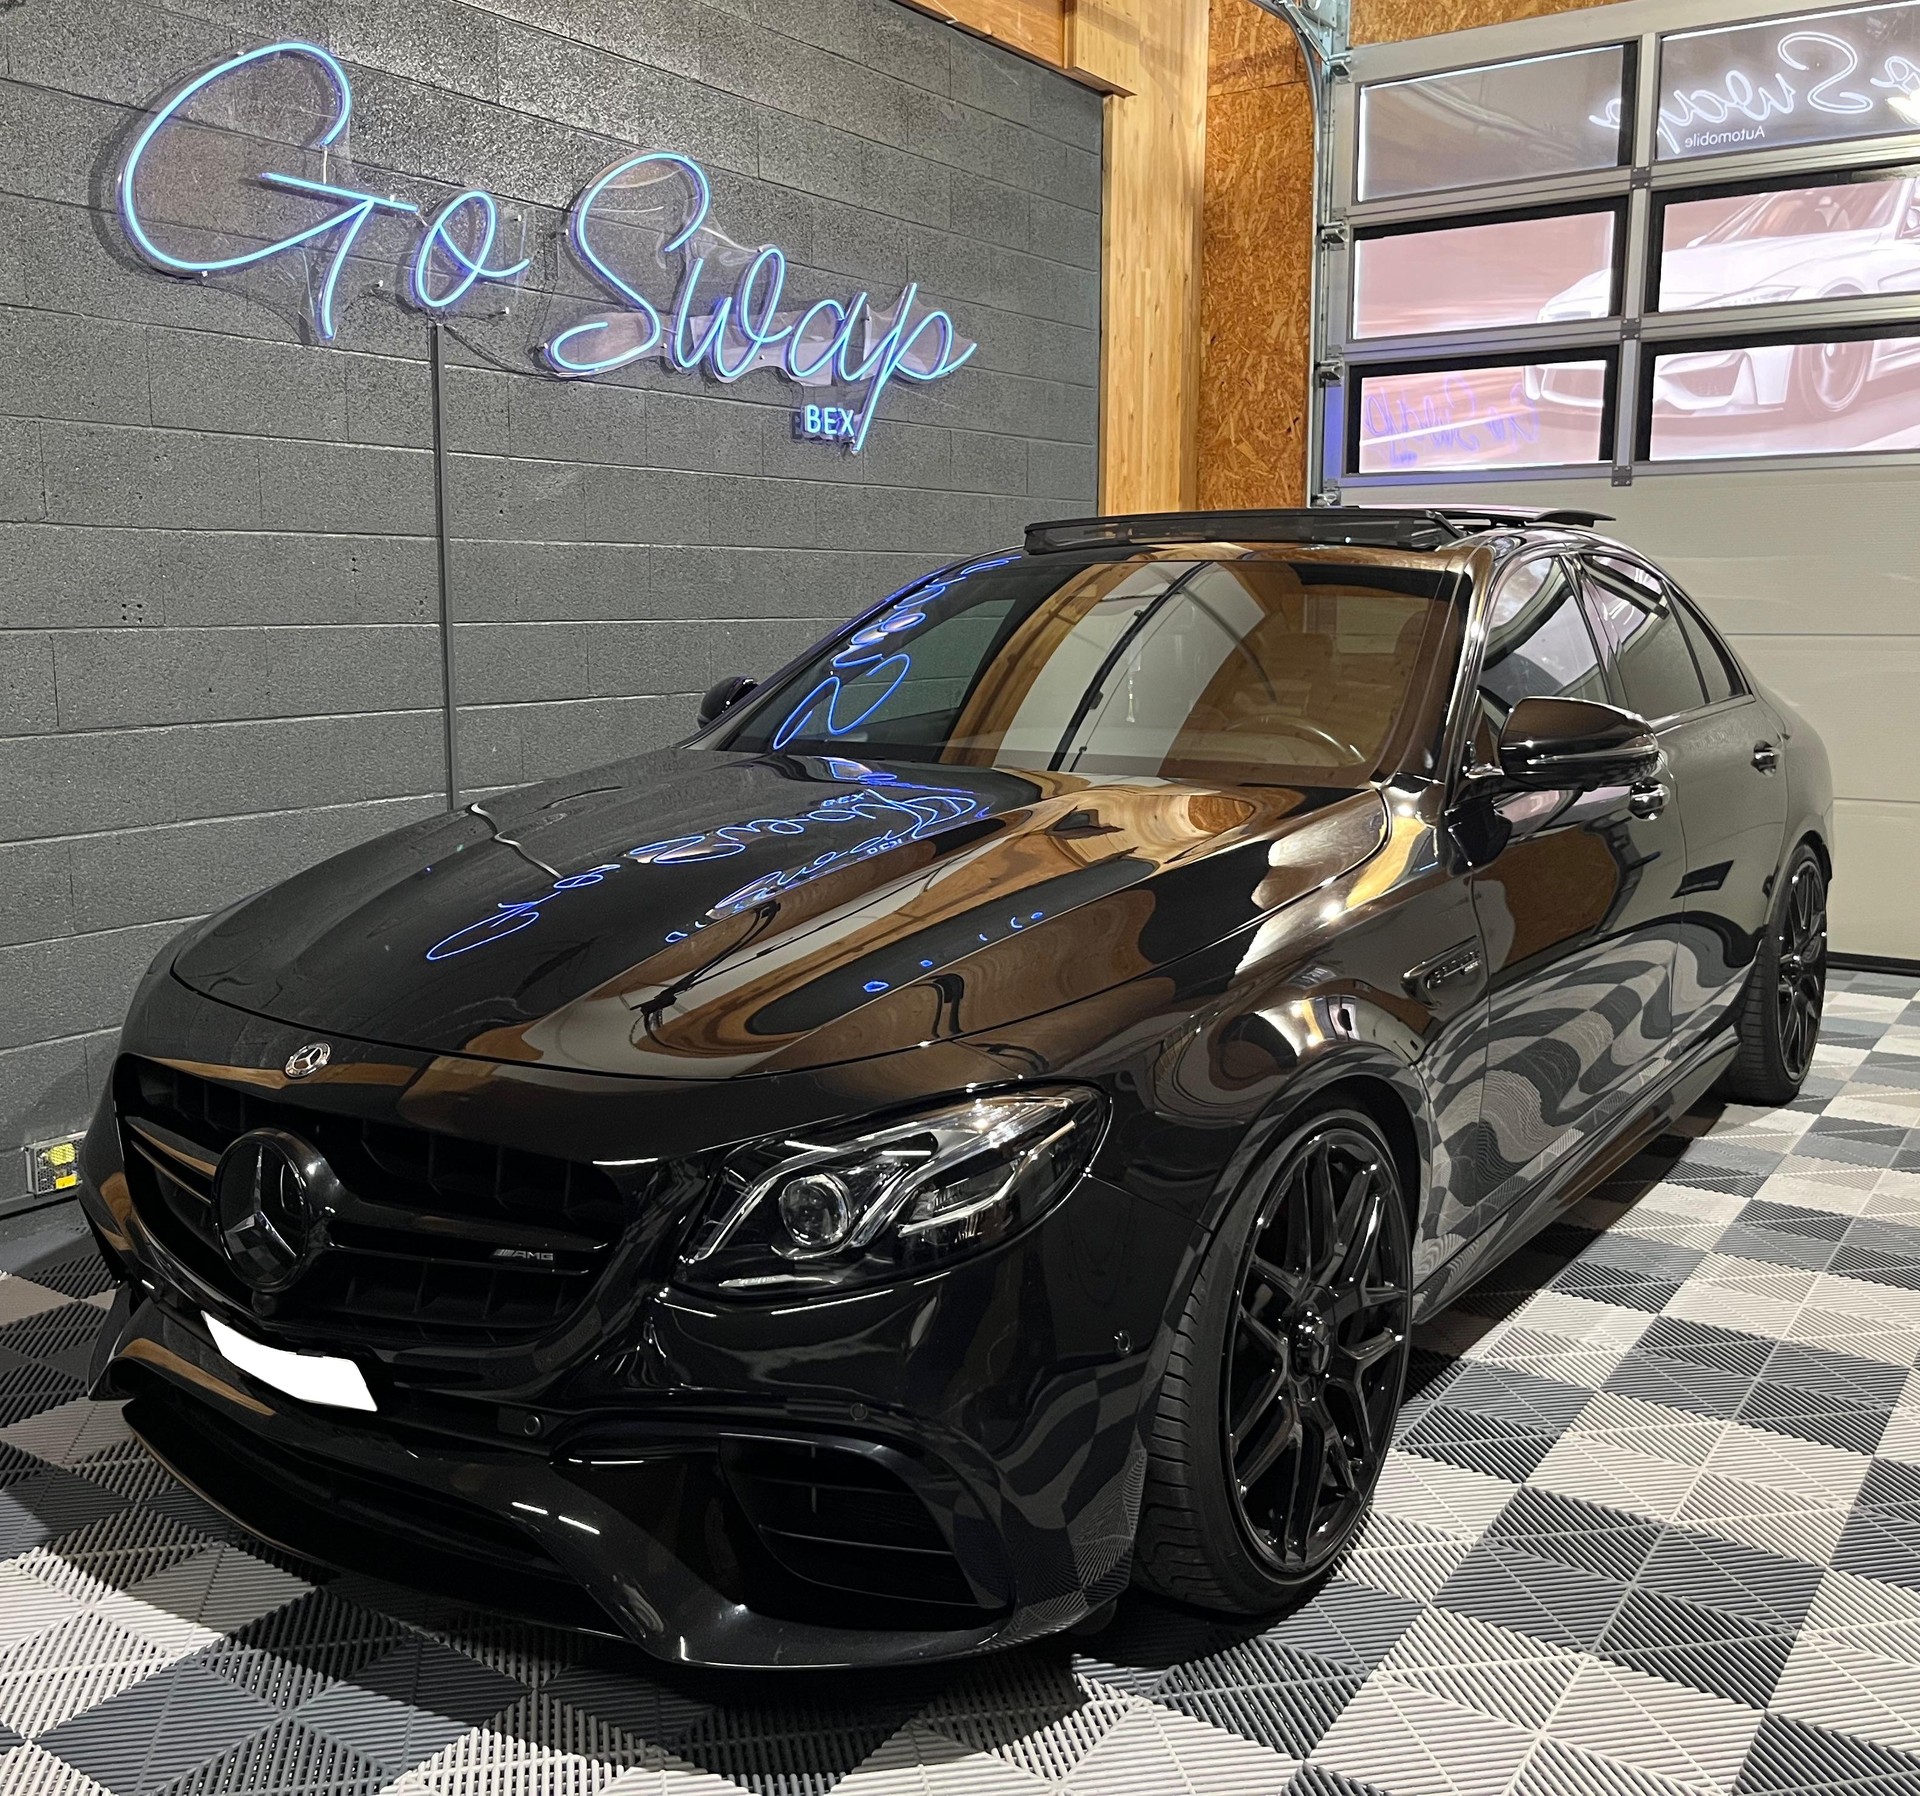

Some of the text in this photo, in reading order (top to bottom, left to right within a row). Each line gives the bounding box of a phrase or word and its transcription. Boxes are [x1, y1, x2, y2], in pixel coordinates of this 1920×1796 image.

[124, 42, 977, 453] Go Swap
[804, 404, 855, 437] BEX
[511, 1250, 554, 1261] AMG
